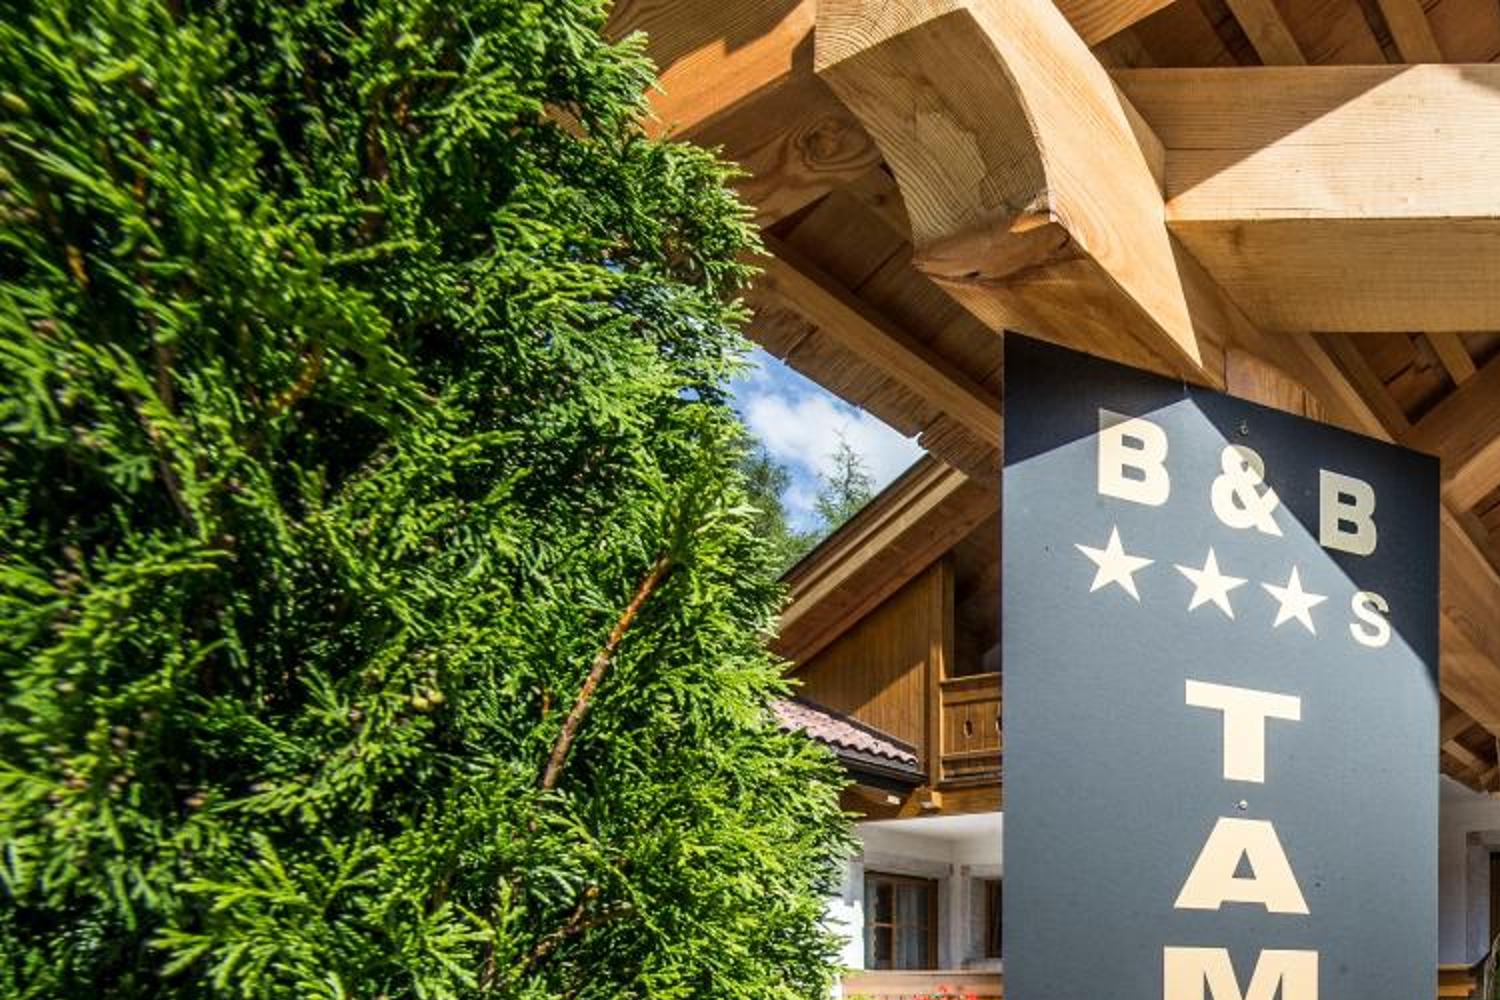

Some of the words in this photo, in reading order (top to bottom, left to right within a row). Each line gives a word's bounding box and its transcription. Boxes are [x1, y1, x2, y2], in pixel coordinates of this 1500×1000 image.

[1098, 408, 1170, 506] B
[1210, 444, 1283, 537] &
[1319, 468, 1378, 557] B
